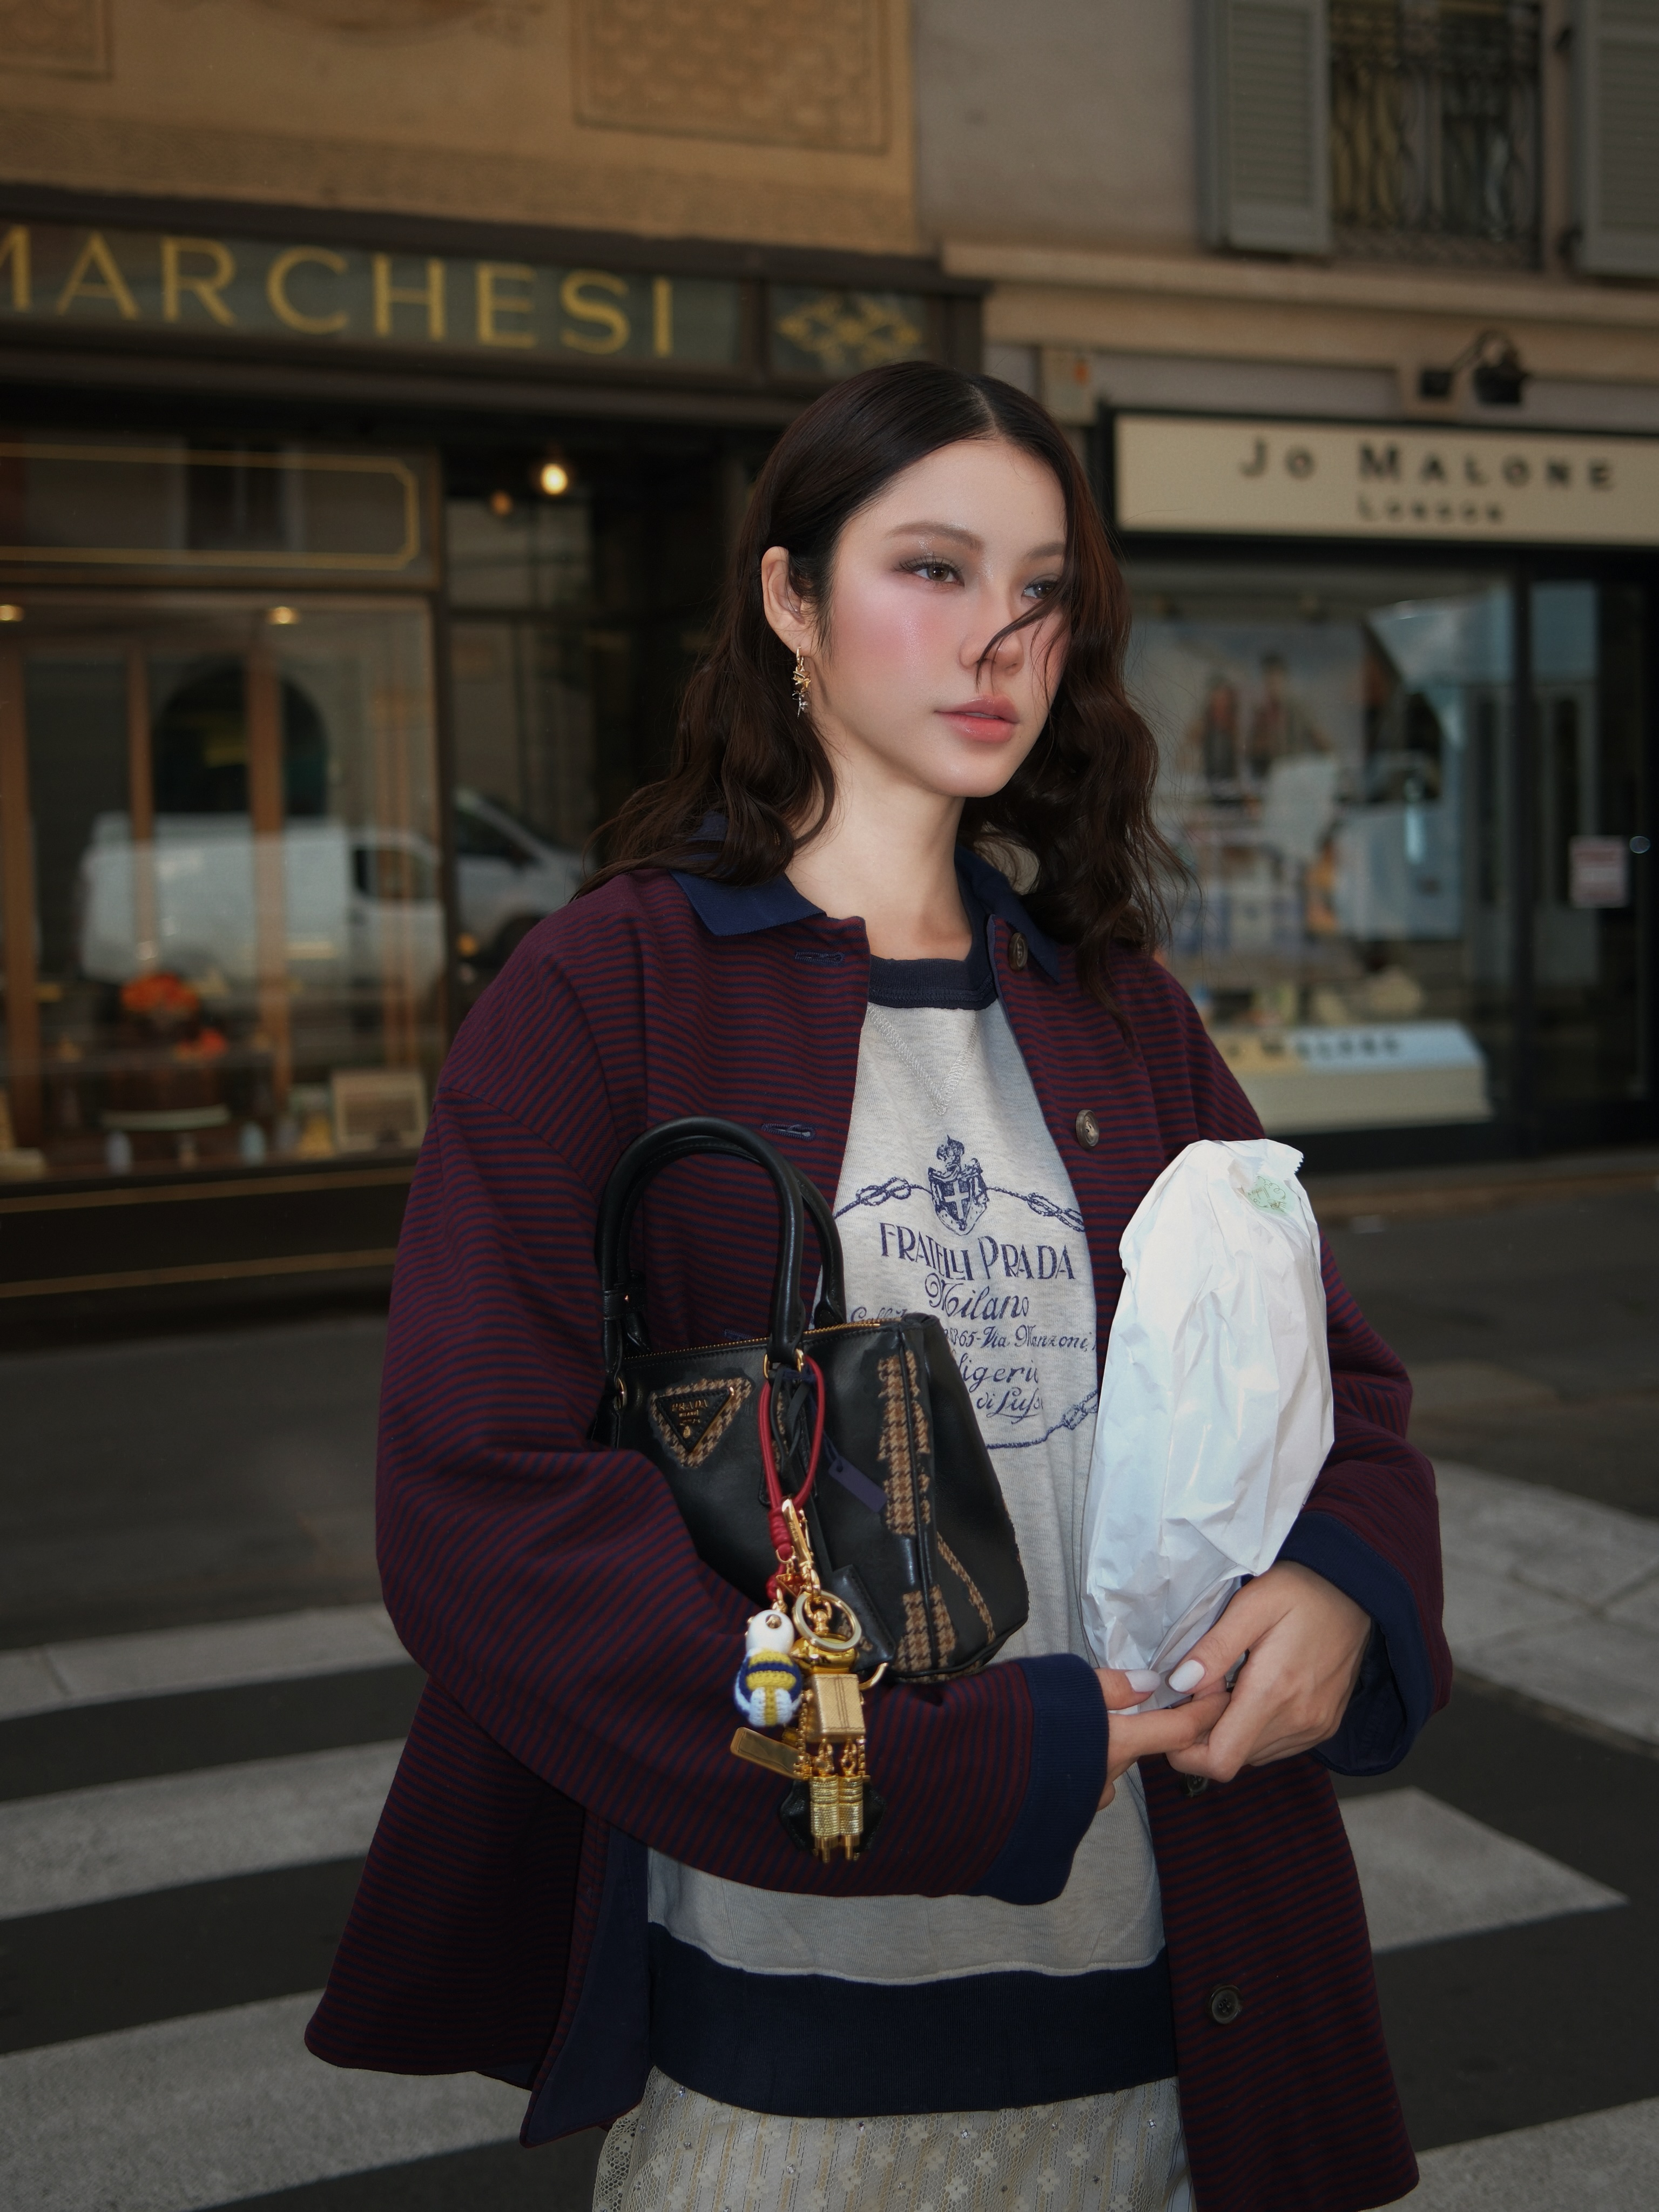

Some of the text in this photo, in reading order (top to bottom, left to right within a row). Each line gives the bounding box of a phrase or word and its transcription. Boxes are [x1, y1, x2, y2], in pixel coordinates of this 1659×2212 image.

[879, 1222, 1076, 1280] FRATELLI PRADA
[925, 1272, 1029, 1320] Milano
[976, 1392, 995, 1410] di
